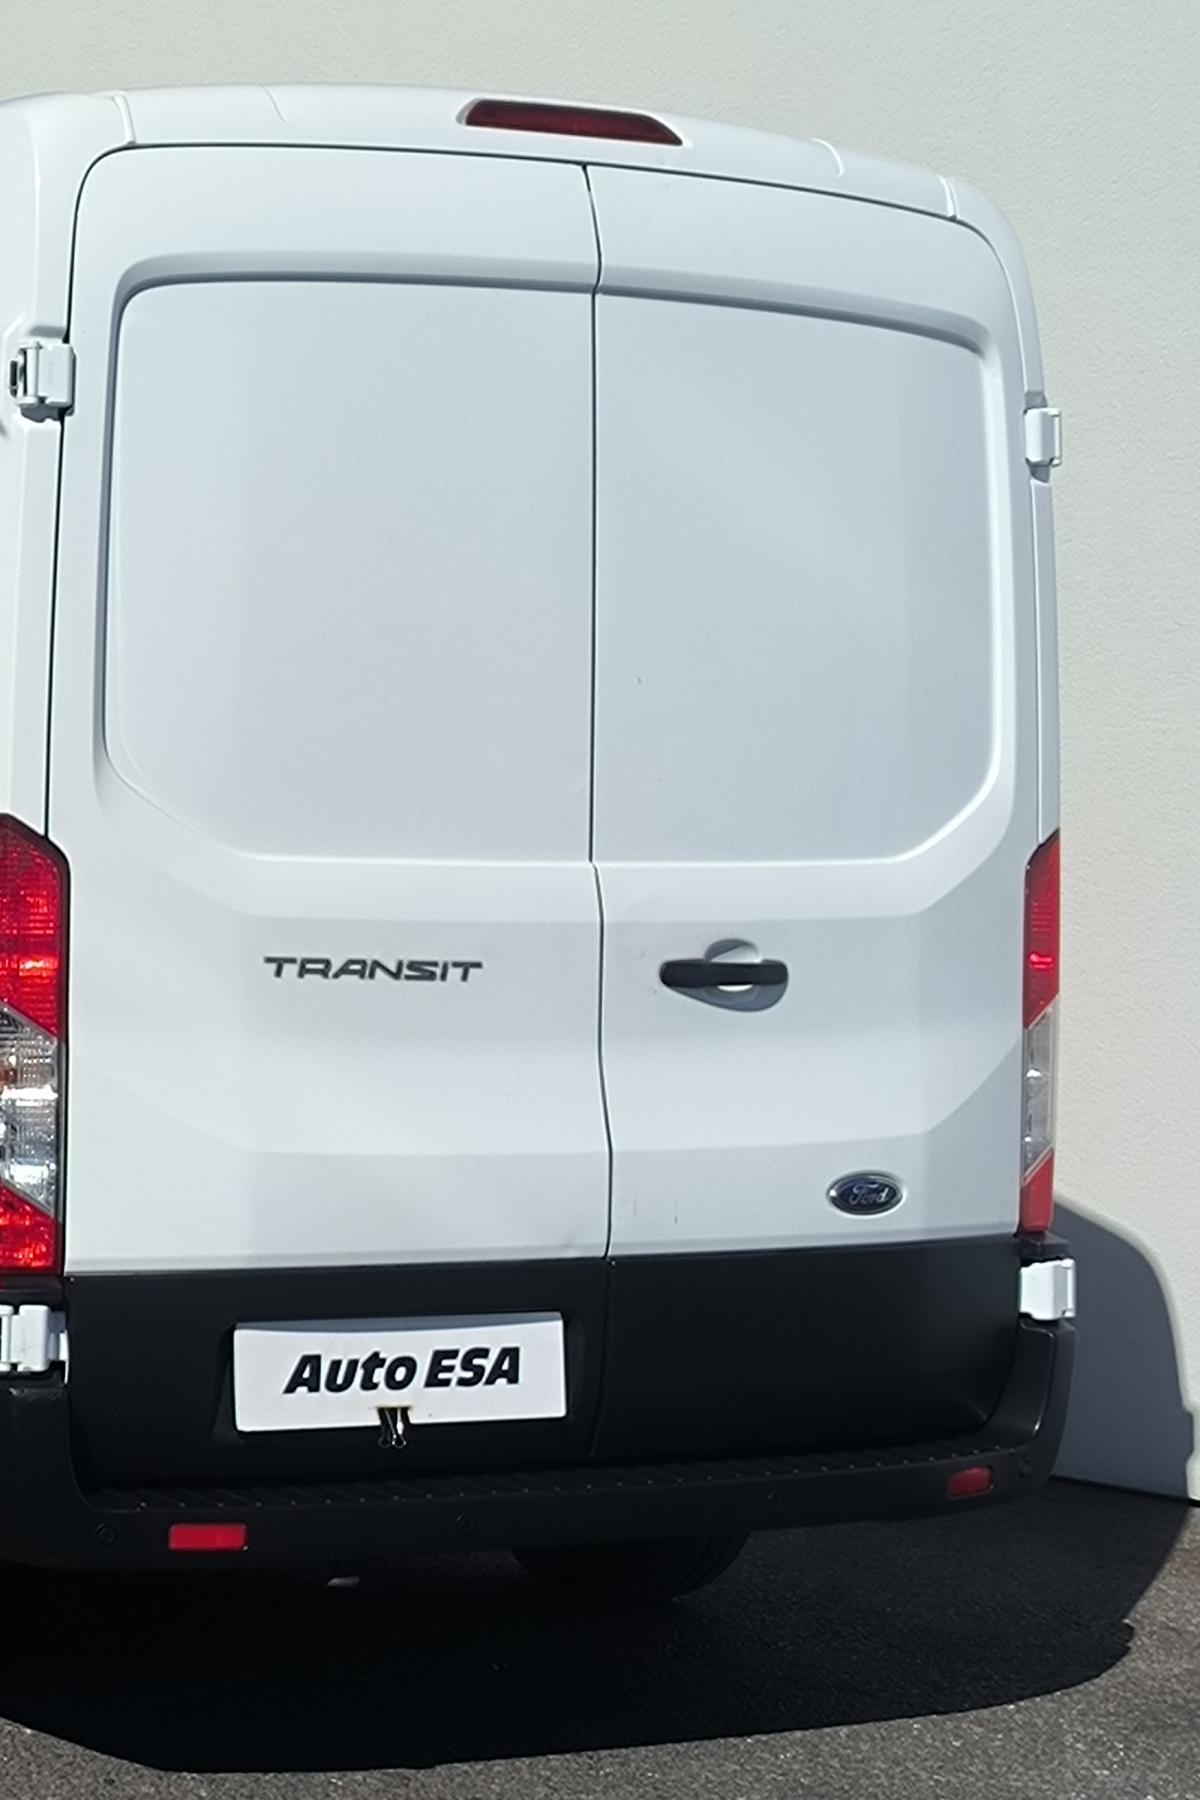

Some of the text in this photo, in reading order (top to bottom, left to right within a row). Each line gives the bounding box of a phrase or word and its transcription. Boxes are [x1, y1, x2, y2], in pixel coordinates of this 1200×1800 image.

[263, 956, 484, 983] TRANSIT
[848, 1183, 889, 1205] Ford
[283, 1346, 521, 1394] Auto ESA
